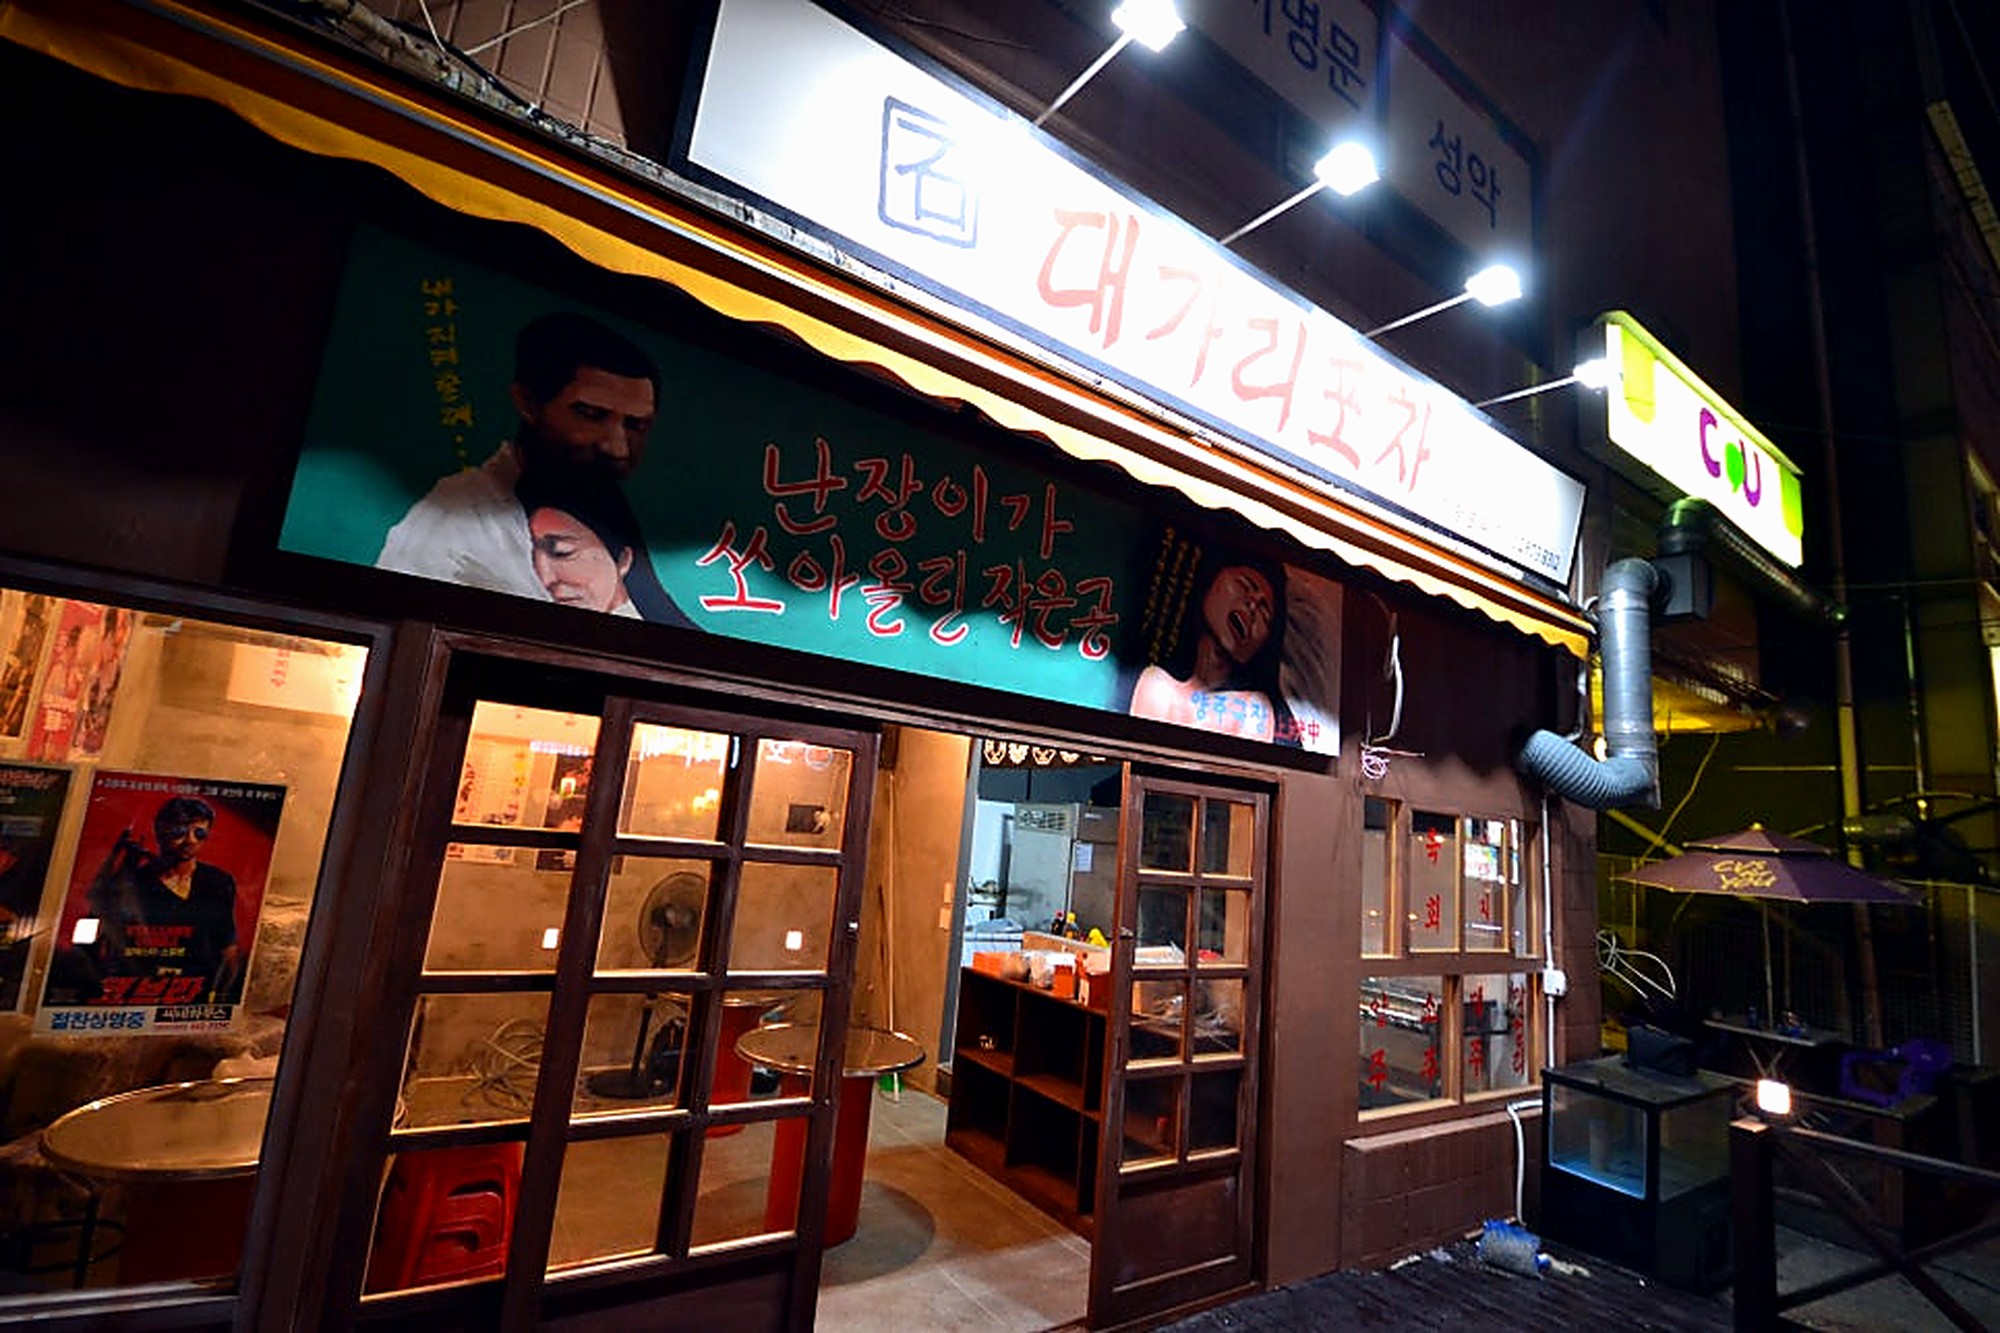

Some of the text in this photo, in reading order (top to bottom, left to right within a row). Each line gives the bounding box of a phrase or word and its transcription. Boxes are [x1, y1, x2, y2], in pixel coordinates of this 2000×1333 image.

[1253, 0, 1366, 110] 명문
[1428, 119, 1502, 229] 성악
[763, 437, 1074, 560] 난장이가
[1700, 408, 1761, 507] CU
[696, 522, 969, 646] 쏘아올린
